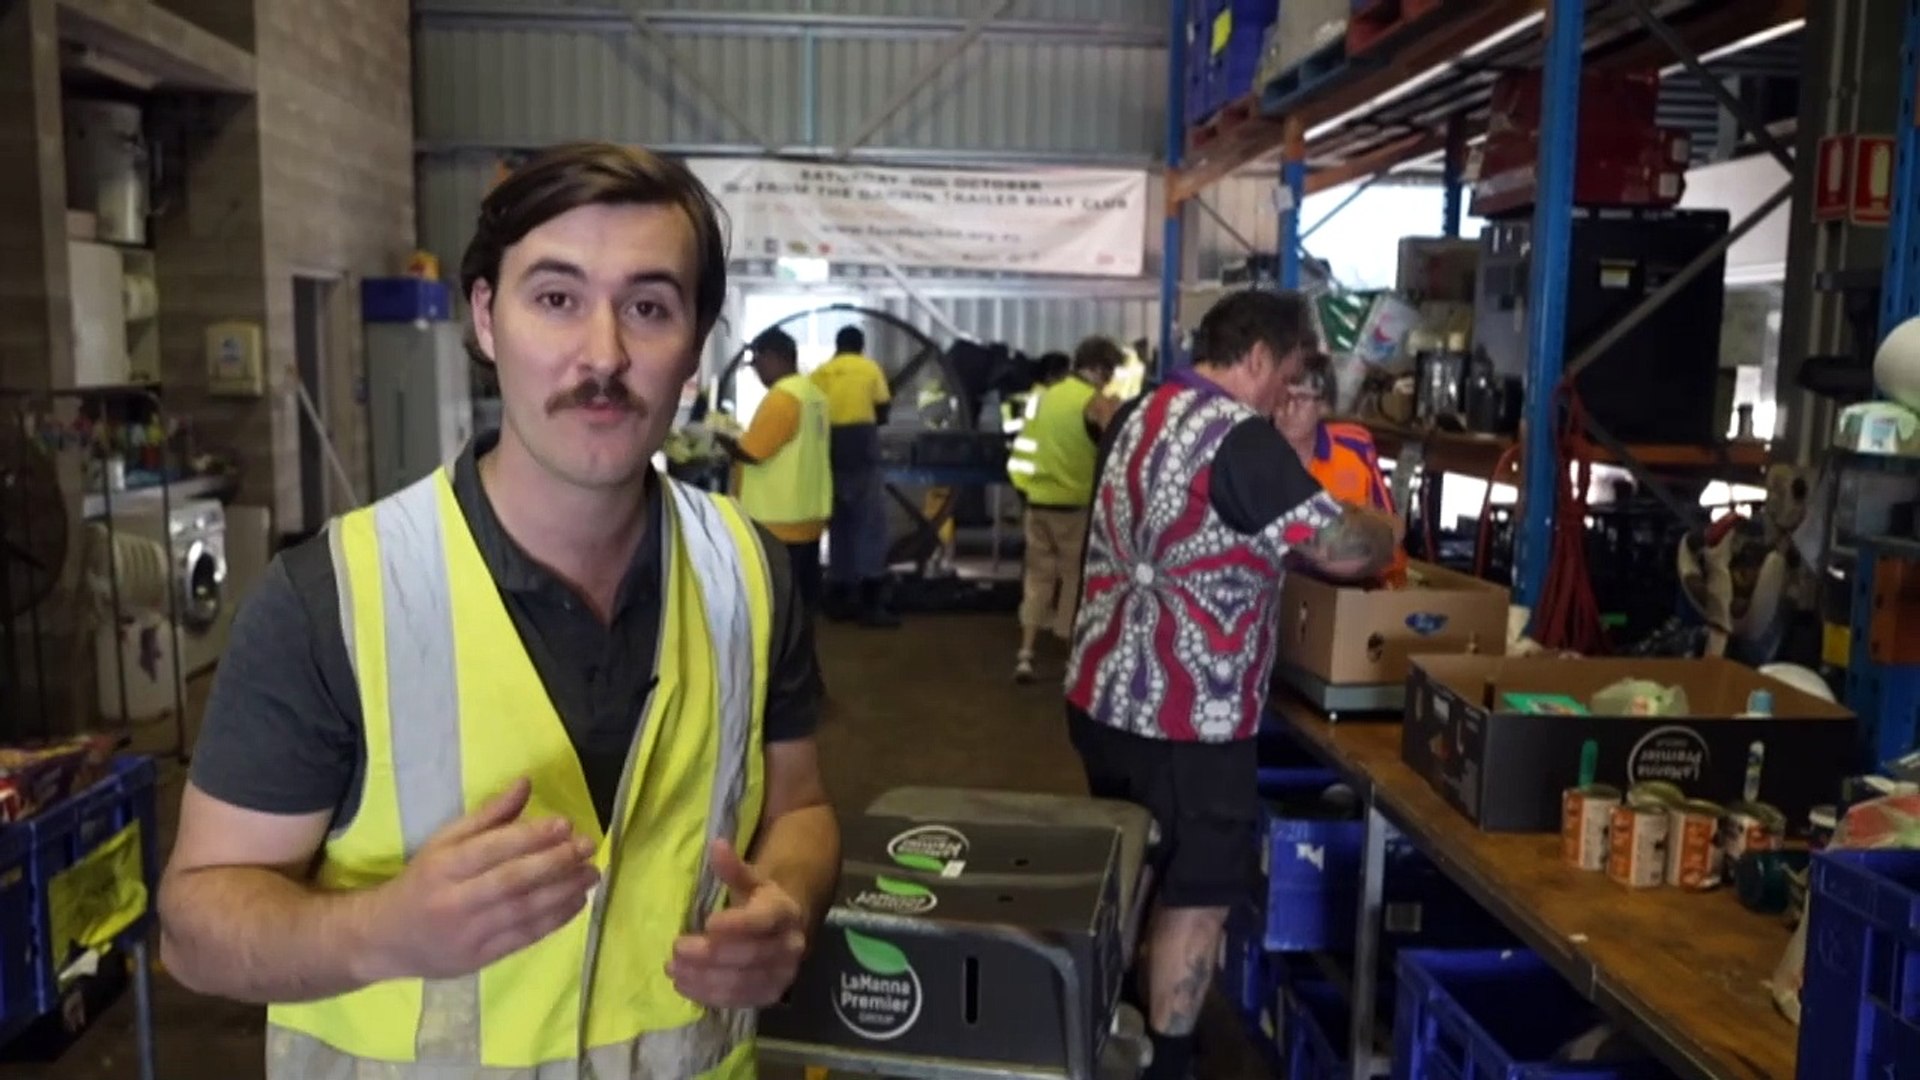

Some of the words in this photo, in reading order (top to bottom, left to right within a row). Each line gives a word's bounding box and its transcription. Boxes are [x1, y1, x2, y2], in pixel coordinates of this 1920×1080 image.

[953, 177, 1042, 190] OCTOBER
[818, 185, 850, 198] THE
[944, 190, 1019, 205] TRAILER
[1025, 194, 1074, 207] BOAT
[841, 972, 910, 996] LaManna
[841, 990, 909, 1013] Premier
